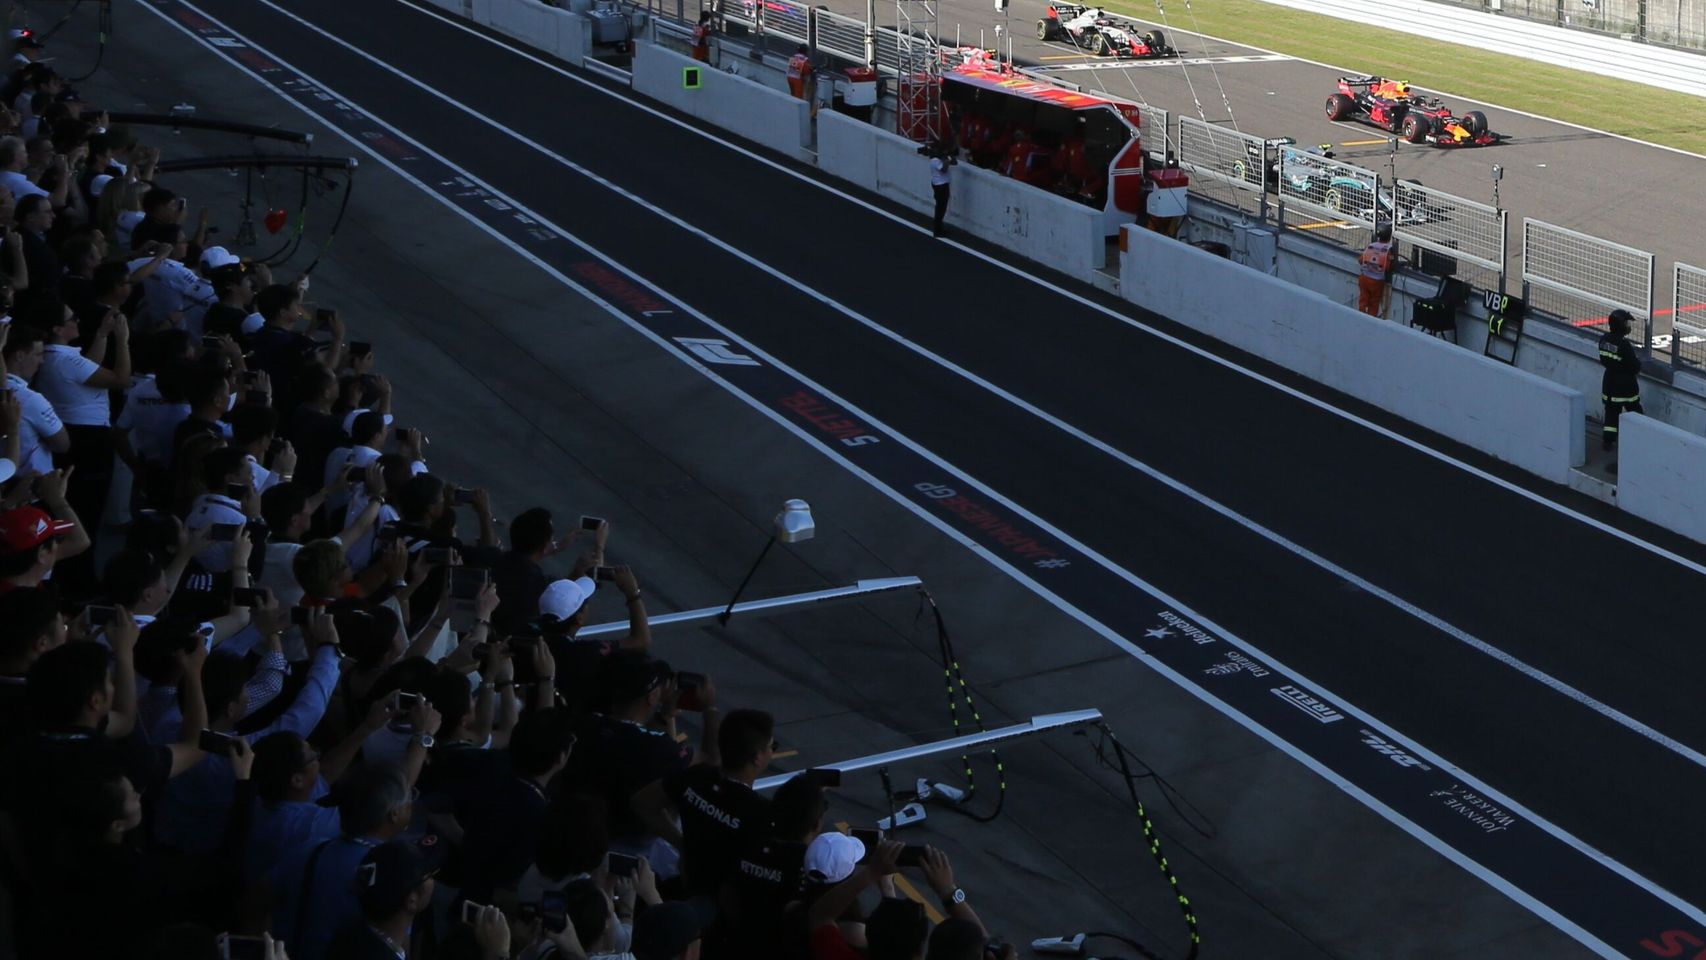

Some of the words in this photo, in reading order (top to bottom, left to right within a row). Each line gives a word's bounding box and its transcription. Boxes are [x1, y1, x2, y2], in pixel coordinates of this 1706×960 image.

[1157, 610, 1217, 645] Heineken
[1226, 650, 1270, 678] Emirates
[1270, 685, 1344, 723] PIRELLI
[1361, 730, 1428, 769] DHL
[684, 786, 740, 829] PETRONAS
[1443, 798, 1507, 833] JOHNNIE
[1464, 793, 1515, 826] WALKER
